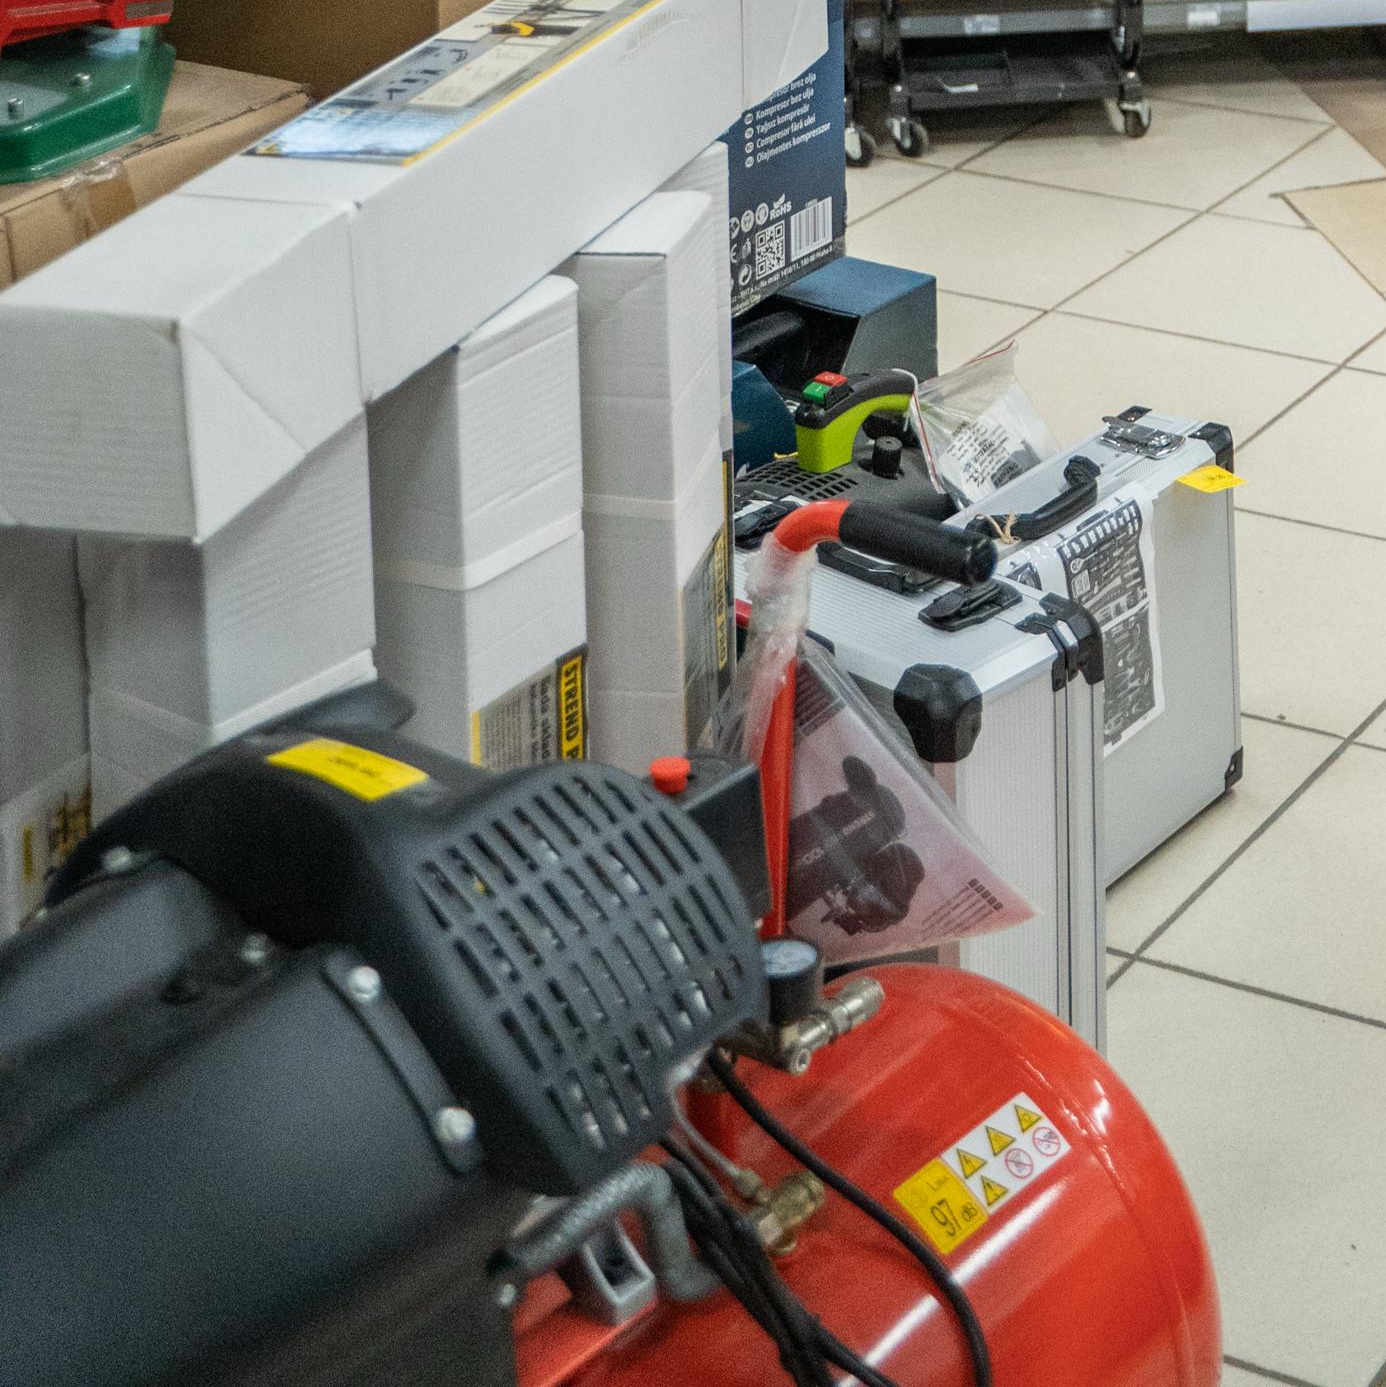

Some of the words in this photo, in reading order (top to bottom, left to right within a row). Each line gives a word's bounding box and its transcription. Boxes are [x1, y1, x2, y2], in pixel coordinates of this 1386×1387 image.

[755, 98, 790, 121] Kompresor
[790, 92, 802, 106] bez
[802, 87, 815, 100] ulja
[756, 126, 790, 149] Compresor
[803, 113, 816, 126] ulei
[756, 141, 792, 164] Olajmentes
[791, 121, 831, 147] kompresszor
[770, 200, 792, 221] RoHS
[563, 665, 581, 742] STREND
[929, 1197, 962, 1238] 97
[961, 1201, 978, 1223] dB
